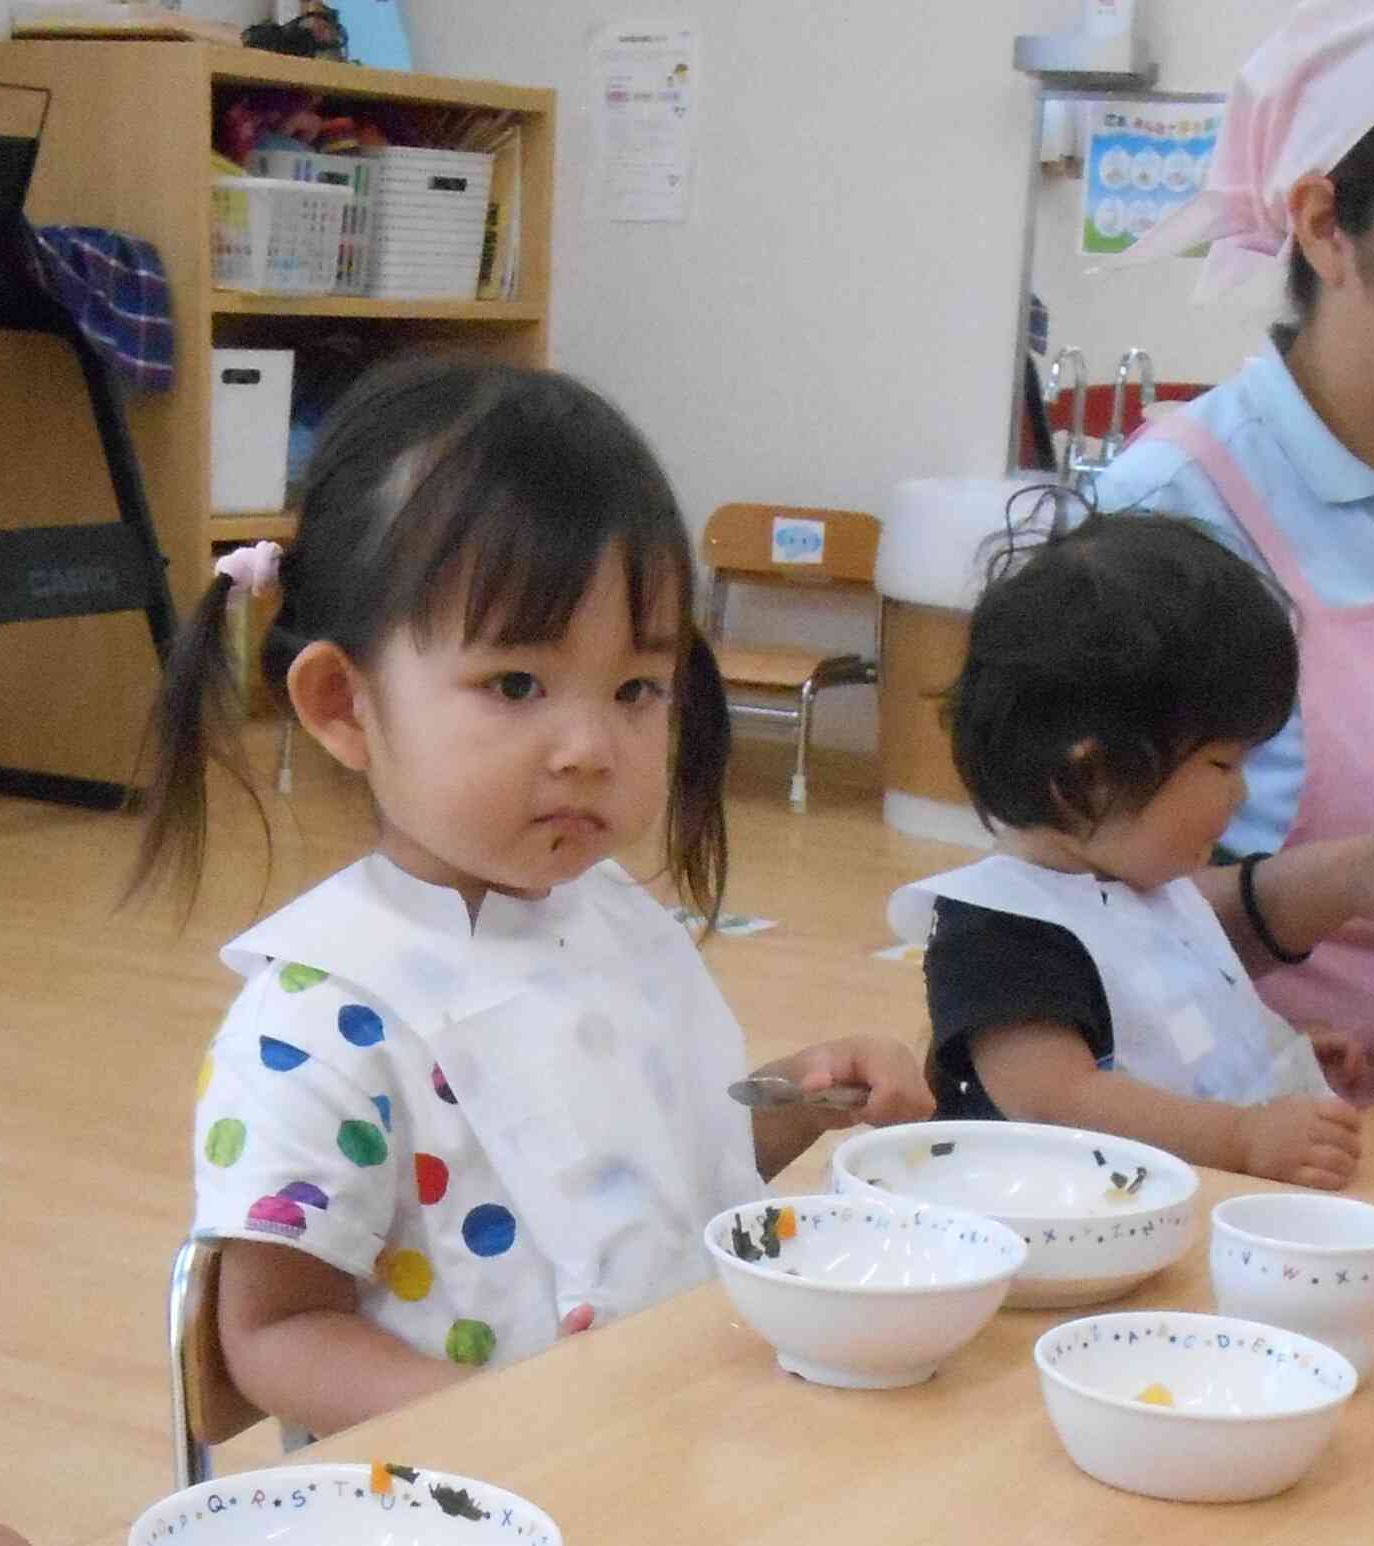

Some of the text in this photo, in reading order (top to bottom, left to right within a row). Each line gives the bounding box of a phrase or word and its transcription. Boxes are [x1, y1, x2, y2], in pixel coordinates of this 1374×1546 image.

[1216, 1334, 1230, 1349] D
[207, 1494, 226, 1513] Q
[251, 1489, 265, 1507] R
[291, 1490, 306, 1508] S
[333, 1480, 349, 1496] T
[502, 1509, 513, 1526] X
